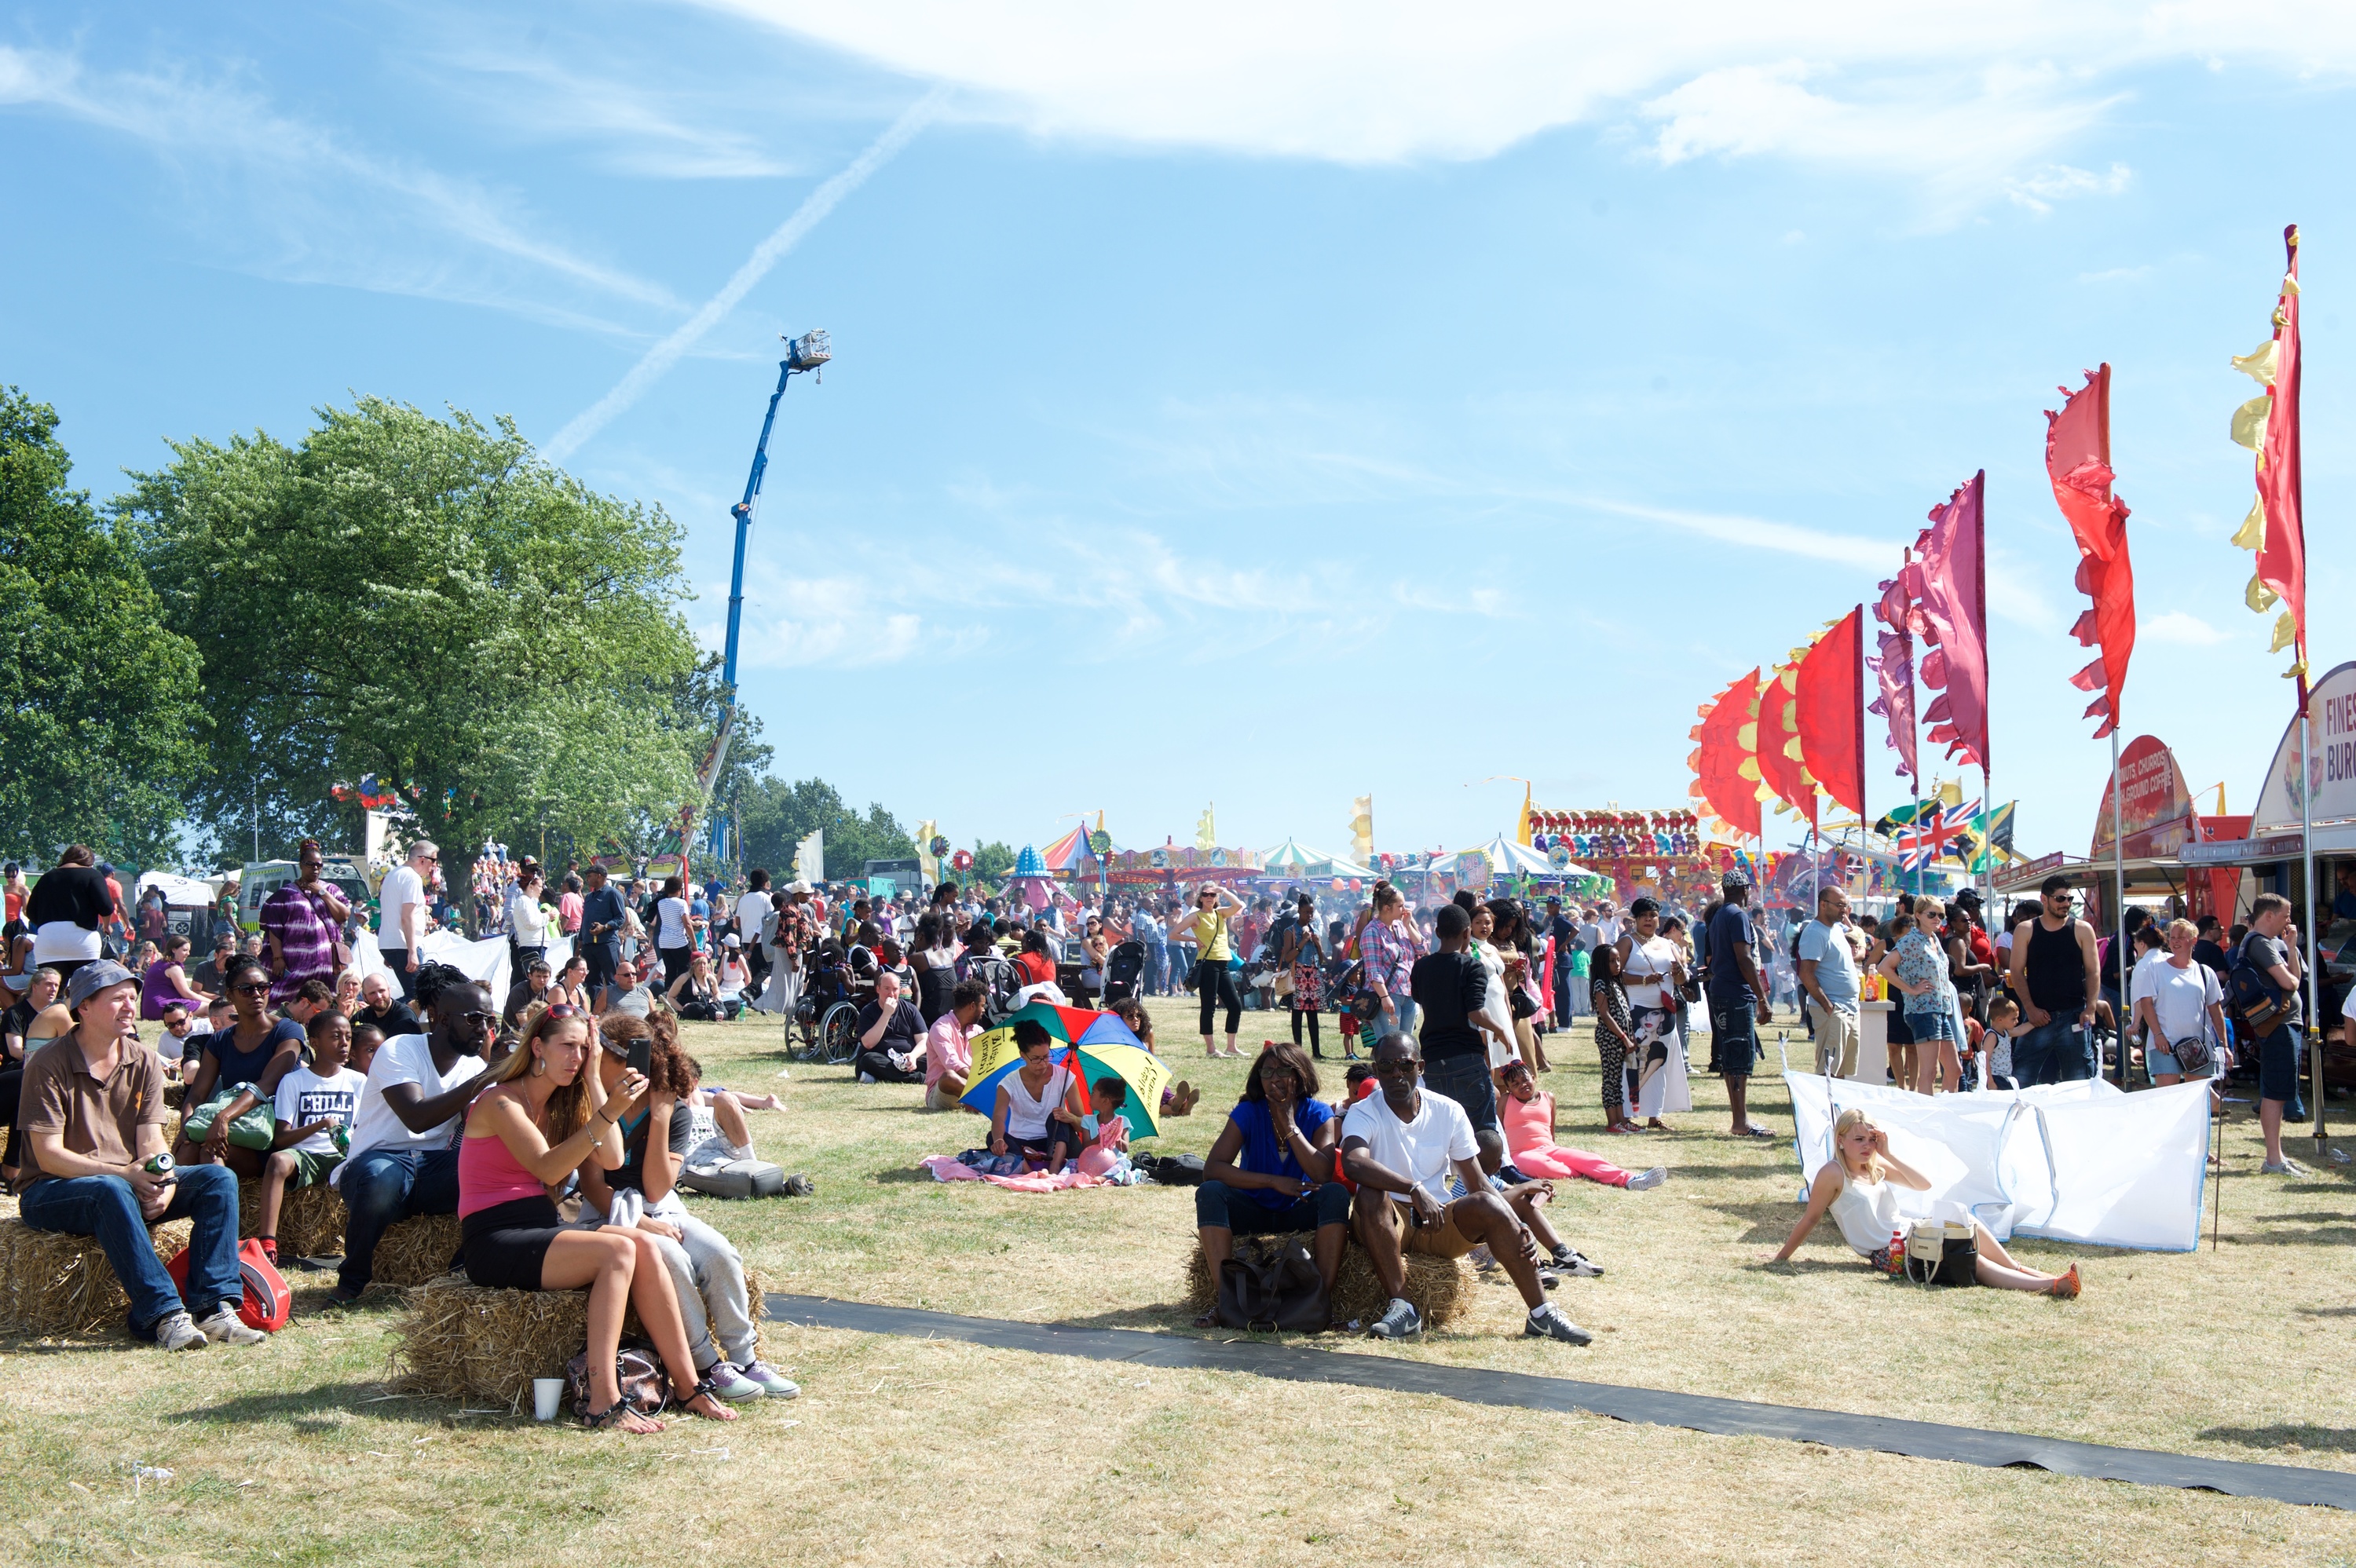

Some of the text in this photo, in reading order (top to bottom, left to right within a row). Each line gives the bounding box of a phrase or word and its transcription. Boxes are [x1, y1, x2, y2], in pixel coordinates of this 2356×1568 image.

[2138, 749, 2165, 776] CHURROS
[2108, 770, 2172, 810] FRH GROUND COFFEE
[1265, 865, 1286, 876] PRIZE
[300, 1095, 352, 1113] CHILL
